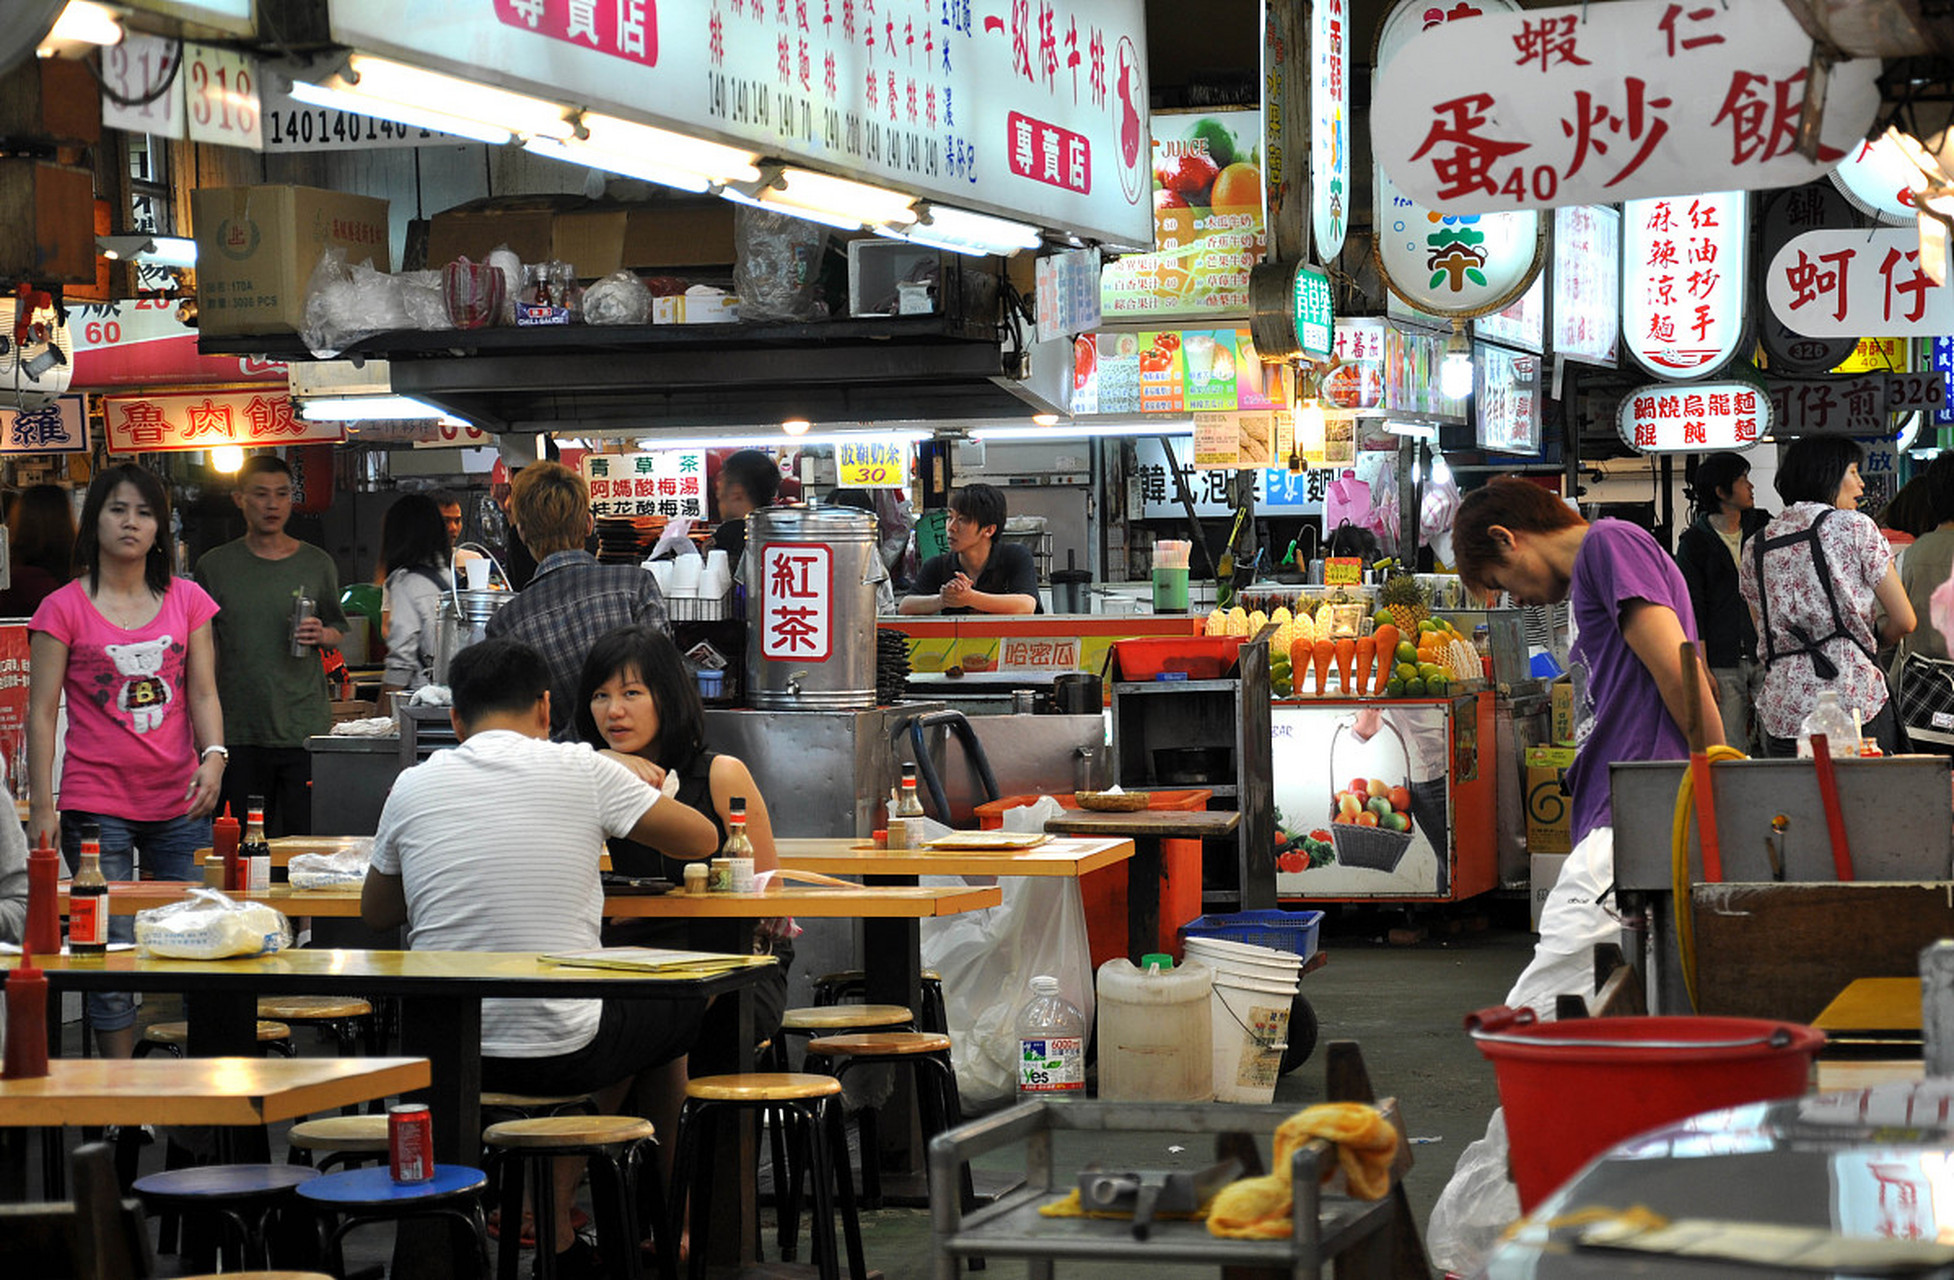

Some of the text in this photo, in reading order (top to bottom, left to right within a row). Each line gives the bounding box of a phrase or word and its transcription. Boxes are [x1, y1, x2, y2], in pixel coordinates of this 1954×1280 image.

[1512, 4, 1727, 72] 蝦仁
[923, 0, 937, 131] 牛排
[191, 60, 255, 134] 318
[271, 110, 313, 143] 140
[1409, 67, 1847, 201] 蛋炒飯
[1015, 118, 1086, 190] 專賣店
[1161, 139, 1210, 158] JUICE
[1502, 165, 1558, 203] 40
[1646, 202, 1679, 343] 麻辣涼麵
[1687, 199, 1721, 342] 紅油抄手
[1784, 247, 1942, 323] 蚵仔
[1295, 274, 1332, 326] 青草茶
[84, 321, 122, 344] 60
[1793, 343, 1823, 358] 326
[1861, 357, 1879, 368] 40
[1634, 391, 1757, 419] 鍋燒烏龍麵
[1891, 377, 1942, 405] 326
[117, 394, 307, 446] 魯肉飯
[1635, 418, 1758, 446] 餛飩麵
[590, 455, 700, 477] 青草茶
[855, 467, 887, 483] 30
[590, 477, 700, 499] 阿媽酸梅湯
[771, 552, 819, 653] 紅茶
[1004, 642, 1075, 667] 哈密瓜
[136, 682, 155, 703] B
